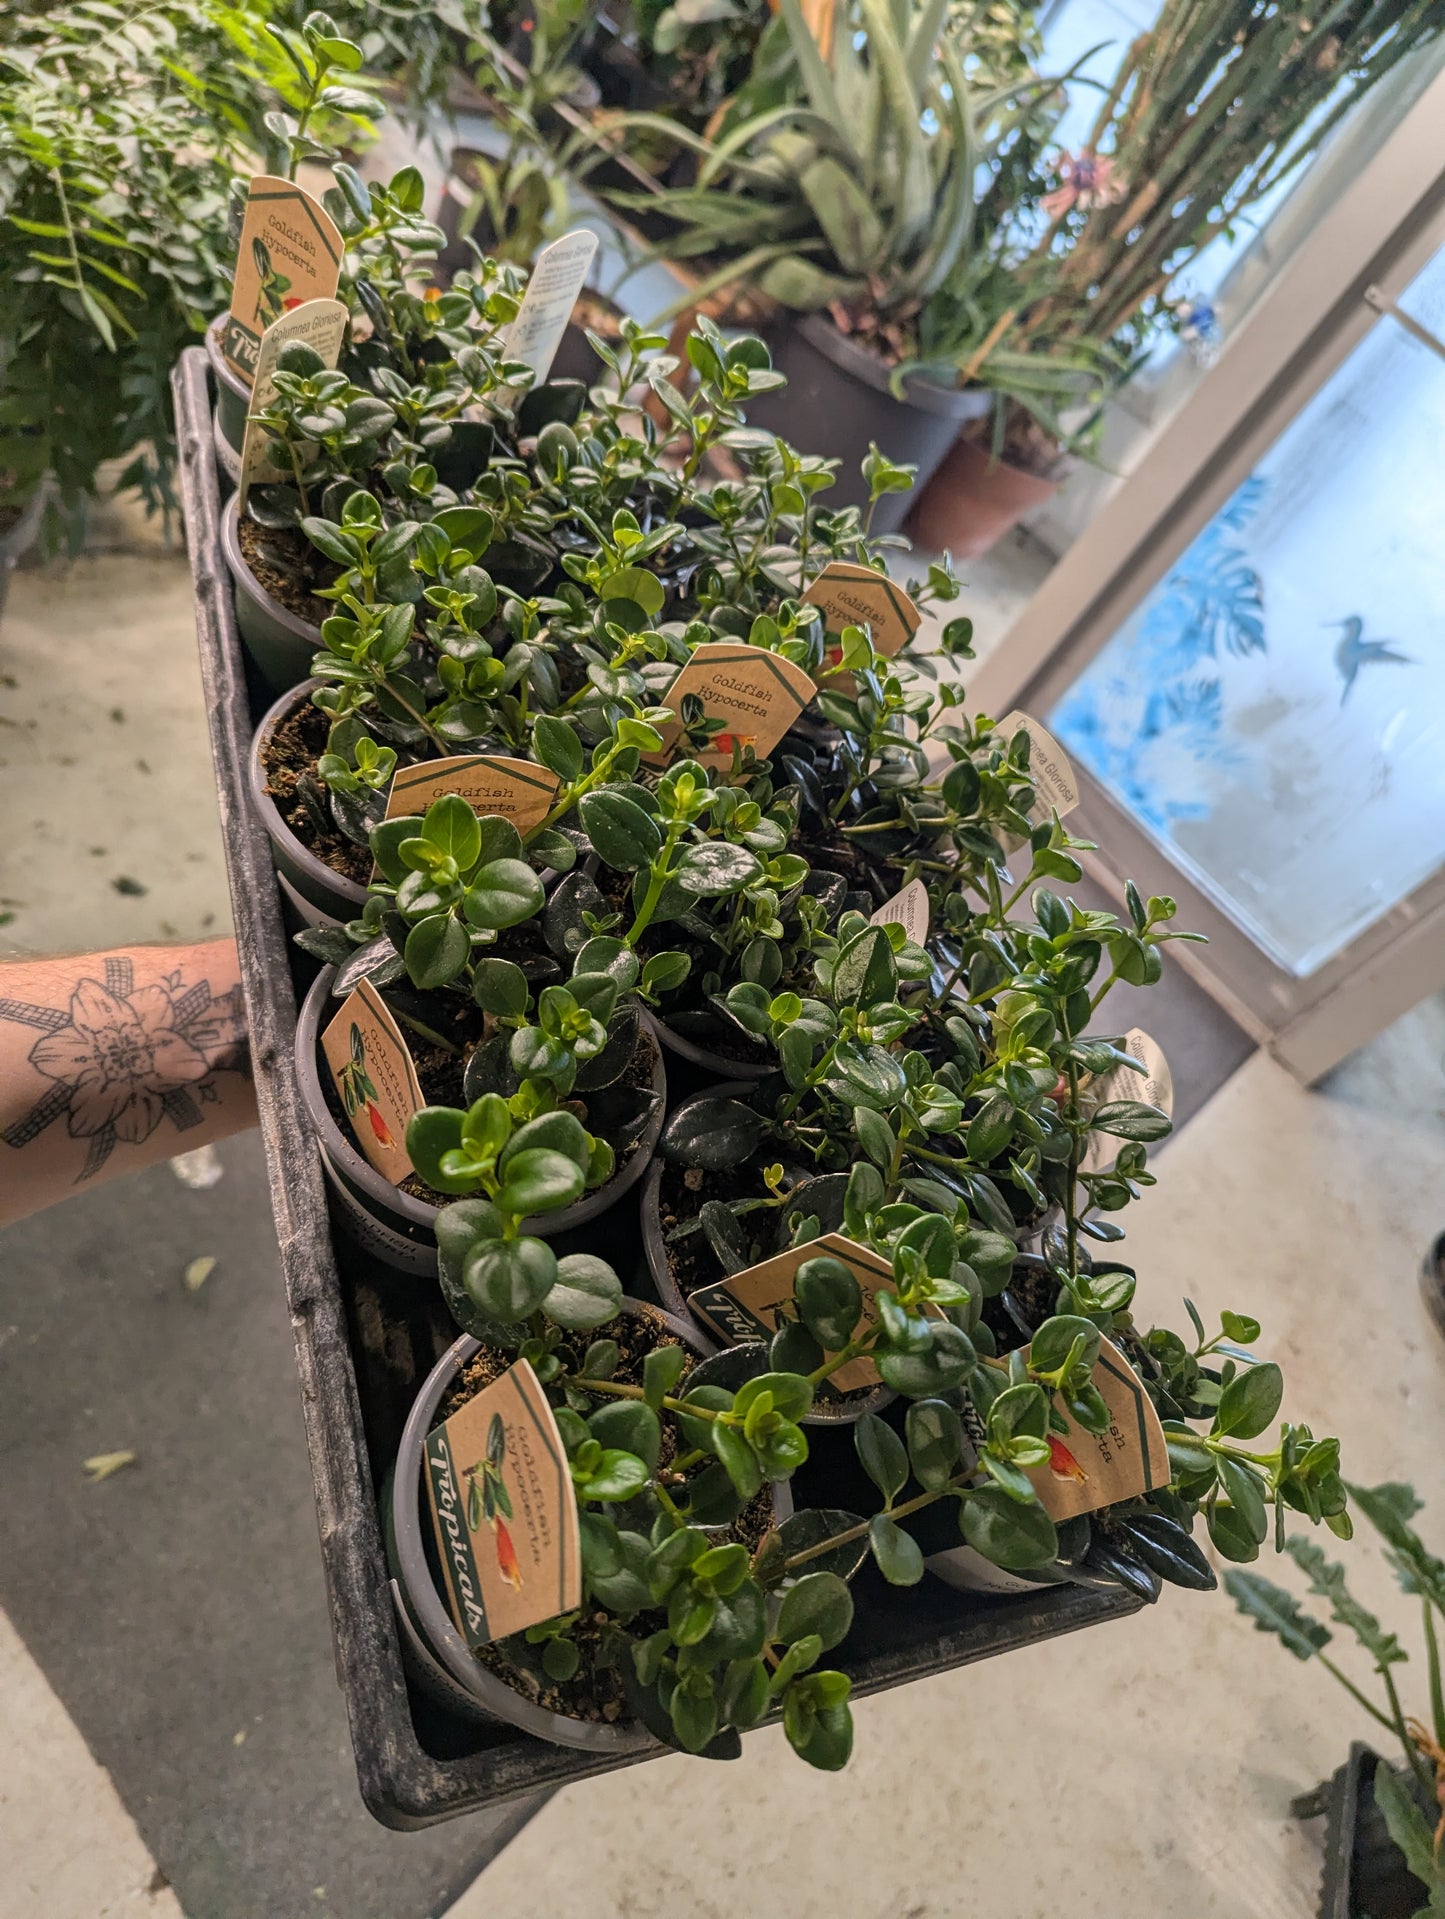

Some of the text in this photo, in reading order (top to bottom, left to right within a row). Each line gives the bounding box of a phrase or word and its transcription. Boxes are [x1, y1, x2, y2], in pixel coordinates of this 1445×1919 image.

[261, 229, 318, 278] Hypocerta
[267, 213, 317, 257] Goldfish
[271, 310, 343, 344] Columnea Gloriosa
[837, 590, 887, 627] Goldfish
[696, 685, 769, 718] Hypocerta
[712, 673, 774, 703] Goldfish
[1044, 762, 1075, 803] Gloriosa
[360, 1027, 406, 1131] Hypocerta
[370, 1028, 410, 1119] Goldfish
[503, 1421, 541, 1567] Hypocerta
[517, 1424, 553, 1551] Goldfish
[429, 1437, 485, 1637] Tropicals
